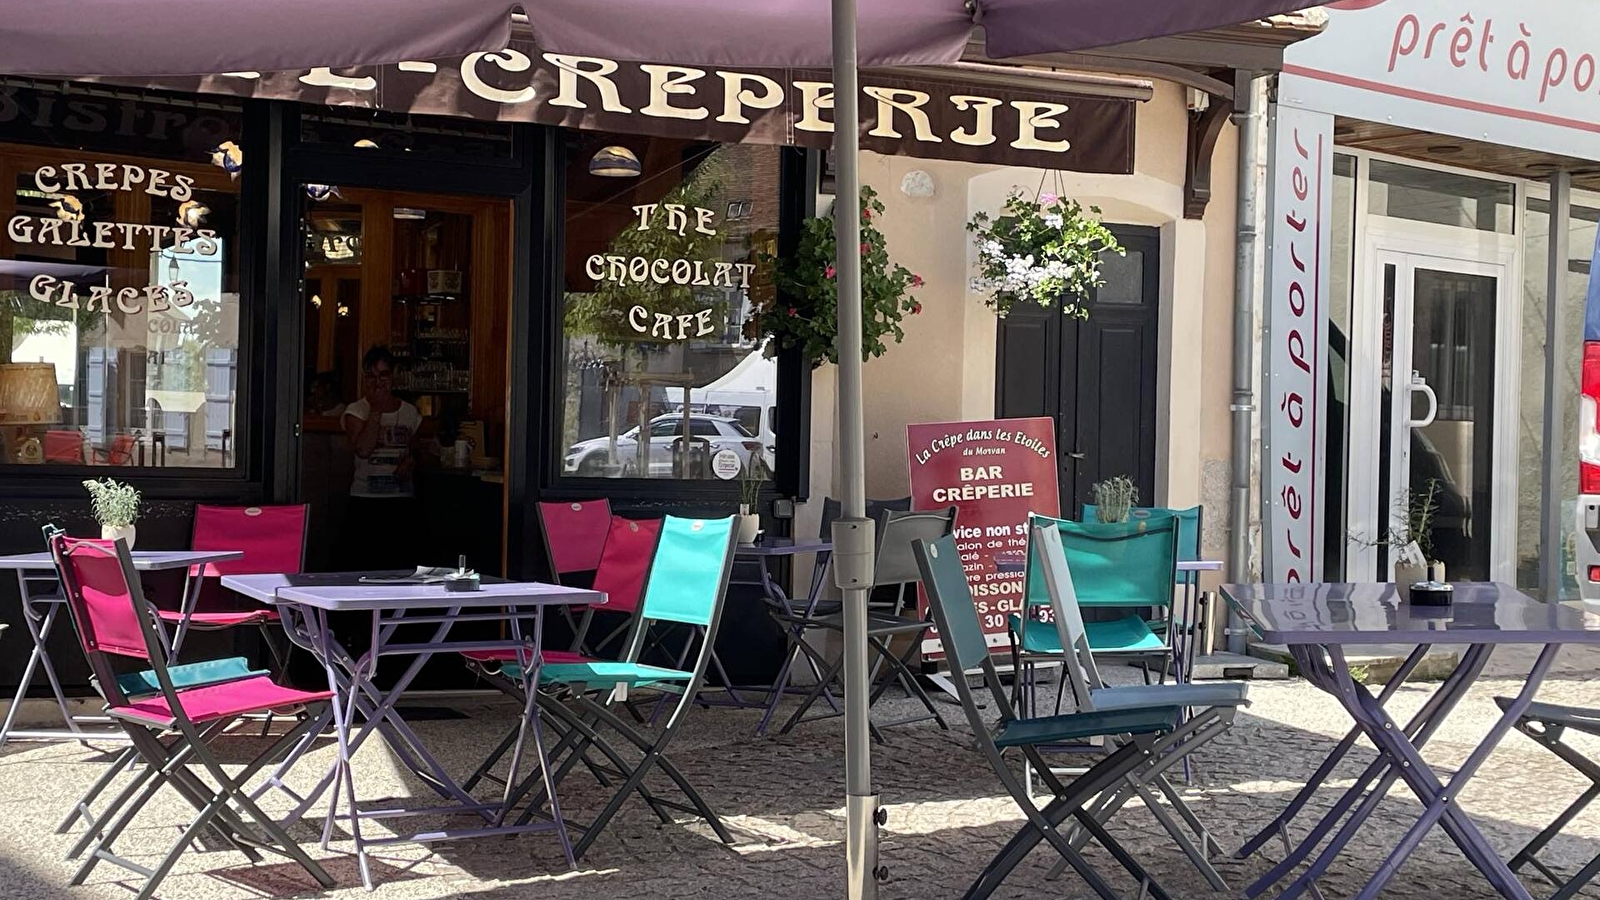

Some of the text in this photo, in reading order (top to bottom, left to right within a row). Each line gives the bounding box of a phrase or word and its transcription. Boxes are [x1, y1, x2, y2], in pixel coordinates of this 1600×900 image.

[1387, 12, 1600, 103] prêt à po
[35, 163, 195, 201] CREPES
[631, 203, 717, 237] THE
[7, 215, 218, 255] GALETTES
[1286, 127, 1311, 375] porter
[585, 254, 756, 289] CHOCOLAT
[29, 274, 195, 315] GLACES
[628, 305, 715, 340] CAFE
[1281, 391, 1303, 428] à
[915, 428, 1051, 465] La Crêpe dans les Etoiles
[962, 447, 1006, 456] du Morvan
[960, 465, 1003, 481] BAR
[932, 483, 1034, 502] CRÊPERIE
[953, 522, 1028, 539] vice non st
[957, 538, 1026, 551] alon de thé
[961, 552, 980, 561] alé
[963, 563, 984, 571] azin
[985, 571, 1025, 581] pressio
[969, 581, 1023, 596] ISSON
[985, 614, 1004, 628] 30
